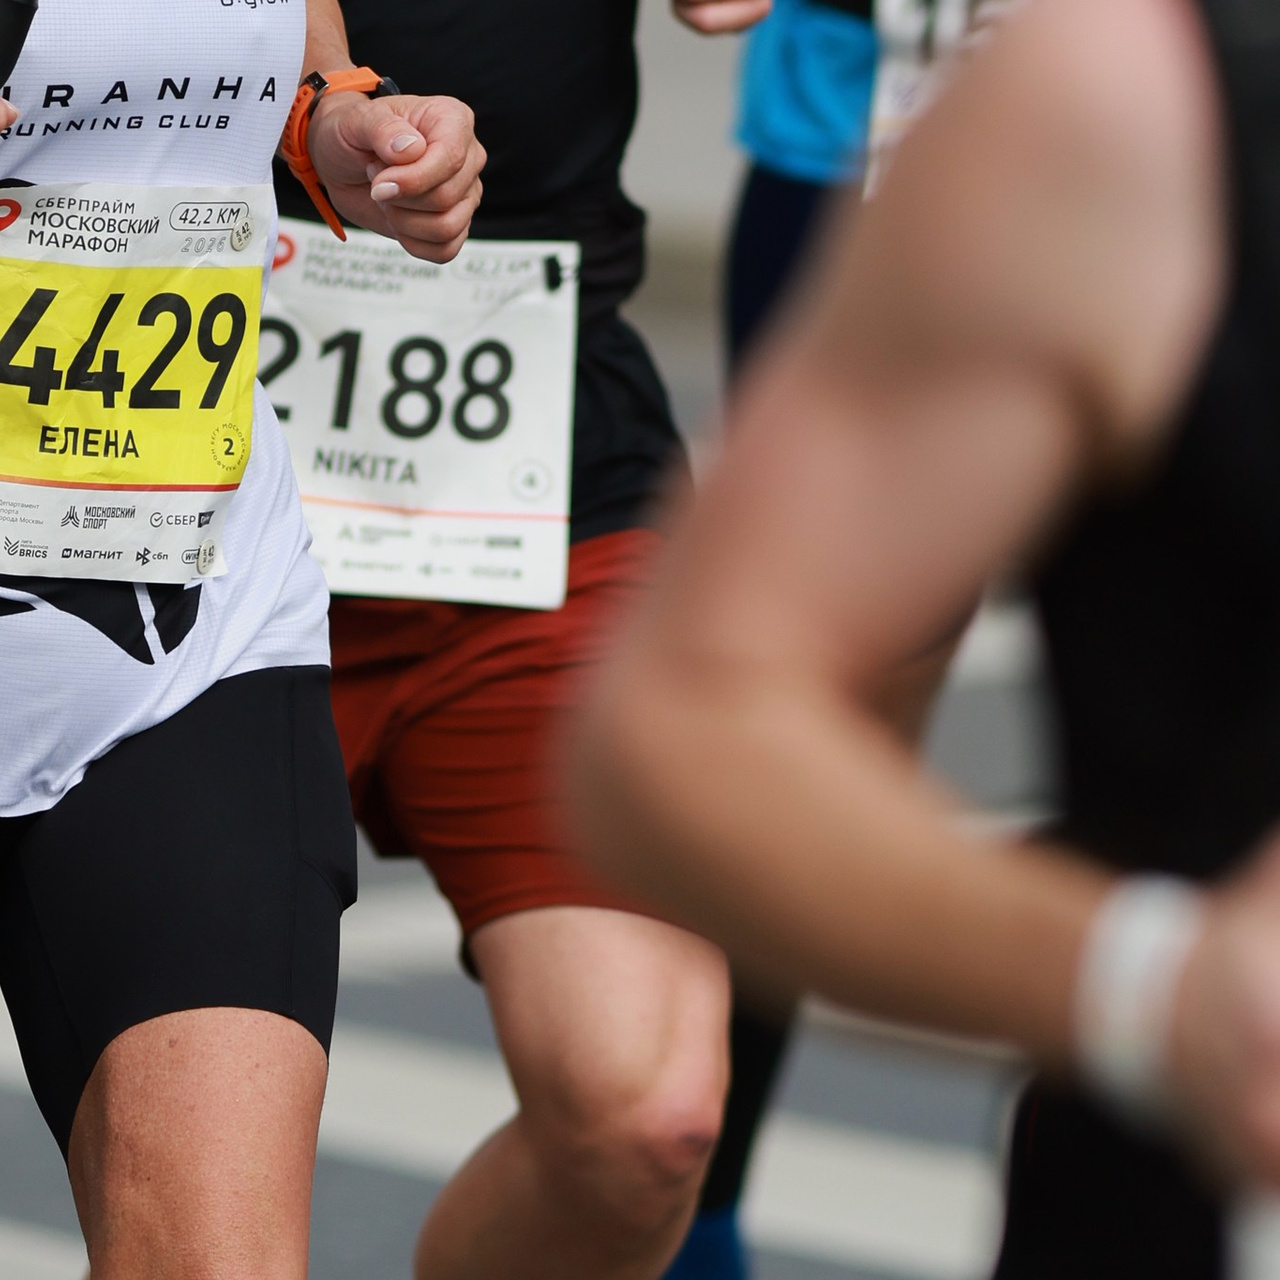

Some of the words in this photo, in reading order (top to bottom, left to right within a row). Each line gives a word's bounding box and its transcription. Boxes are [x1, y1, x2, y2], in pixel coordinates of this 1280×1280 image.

[2, 77, 276, 109] IRANHA
[158, 115, 231, 129] CLUB
[35, 197, 135, 215] СБЕРПРАЙМ
[30, 211, 160, 234] МОСКОВСКИЙ
[178, 207, 214, 227] 42,2
[28, 230, 129, 253] МАРАФОН
[38, 425, 140, 459] ЕЛЕНА
[223, 437, 235, 456] 2
[313, 447, 417, 485] NIKITA
[83, 505, 136, 518] МОСКОВСКИЙ
[166, 514, 196, 525] СБЕР
[82, 518, 108, 529] СПОРТ
[19, 548, 48, 559] BRICS
